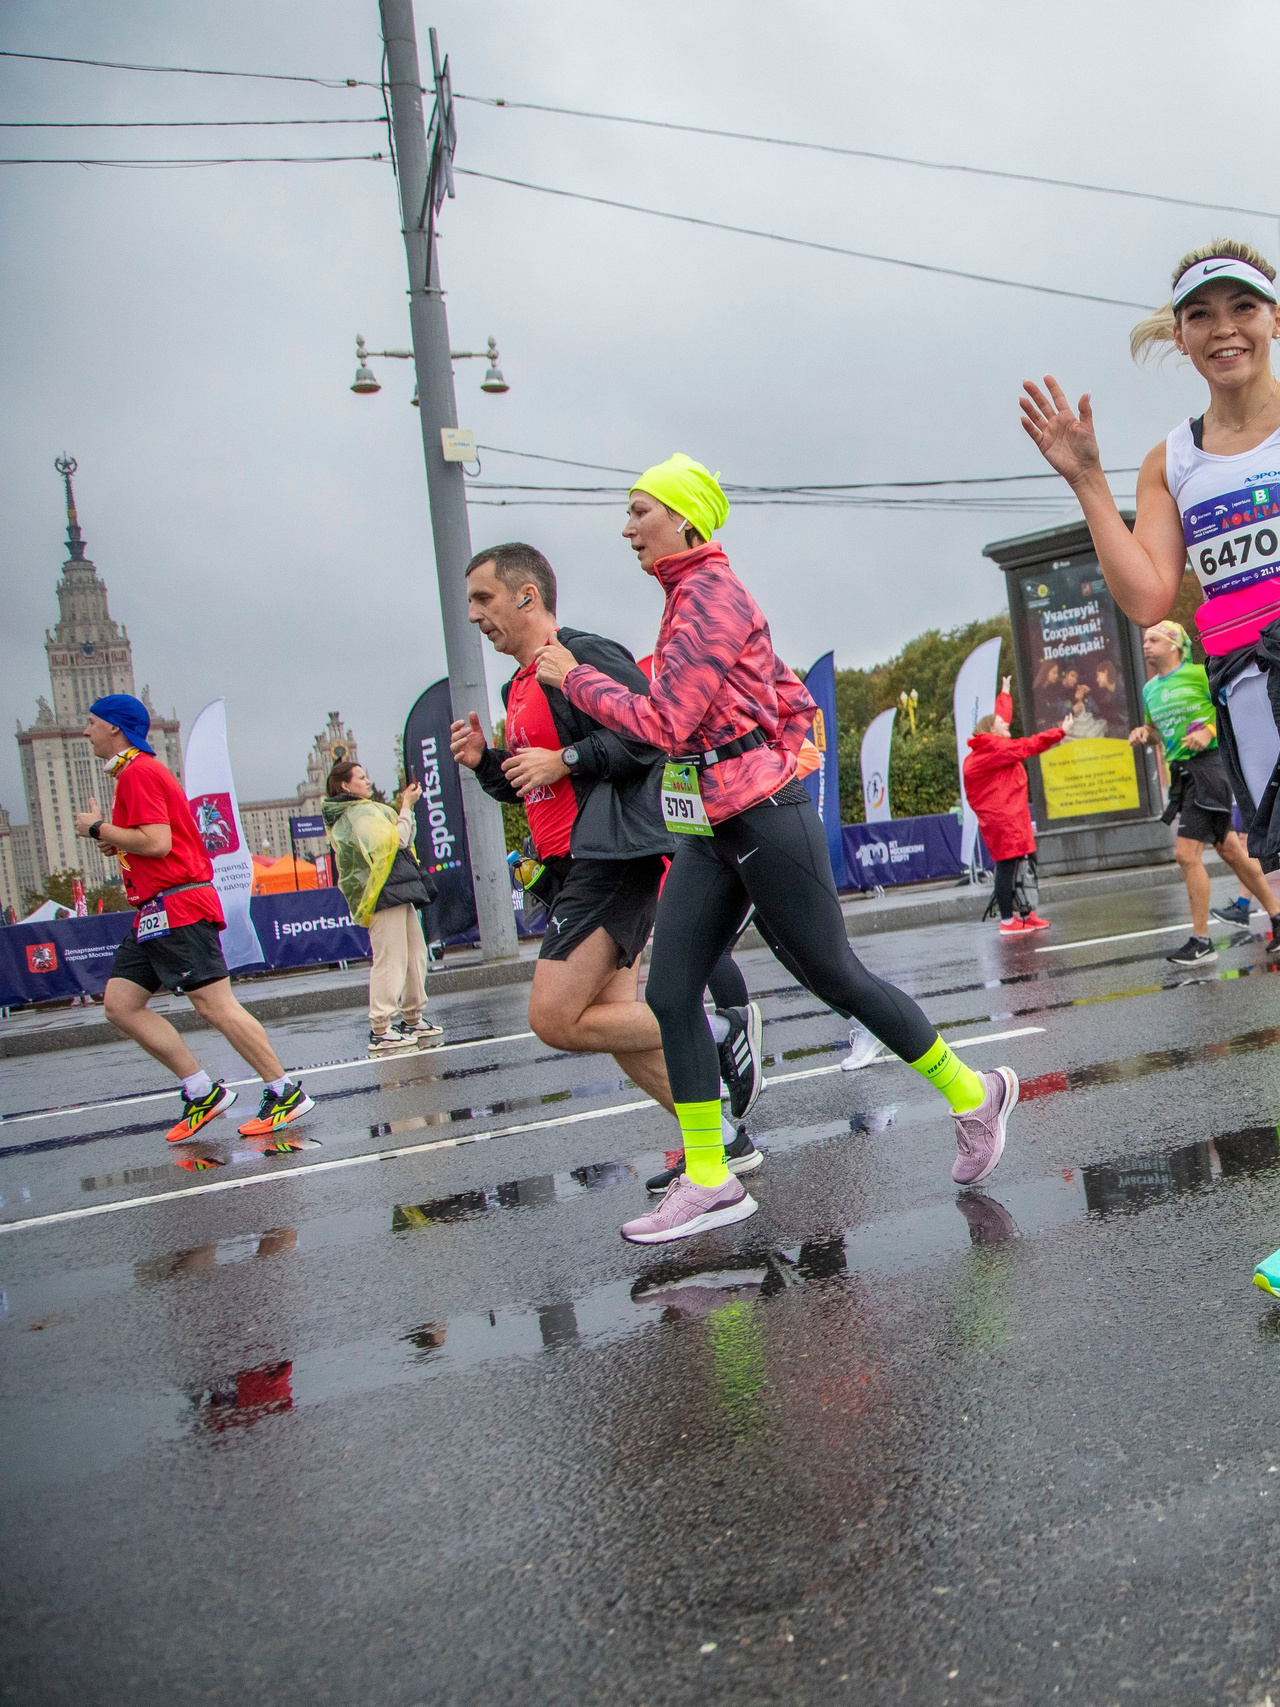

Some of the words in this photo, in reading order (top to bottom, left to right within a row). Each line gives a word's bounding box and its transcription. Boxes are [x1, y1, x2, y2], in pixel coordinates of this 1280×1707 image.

[1200, 528, 1278, 576] 6470
[1261, 566, 1274, 576] 21.1
[1043, 600, 1099, 624] Участвуй!
[1042, 618, 1102, 642] Сохраняй!
[1043, 636, 1105, 660] Побеждай!
[815, 712, 823, 748] PRO
[421, 737, 455, 860] sports.ru
[665, 796, 694, 818] 3797
[855, 842, 889, 867] 100
[282, 915, 355, 937] sports.ru
[65, 945, 105, 956] Департамент
[65, 954, 88, 962] города
[89, 951, 113, 959] Москвы
